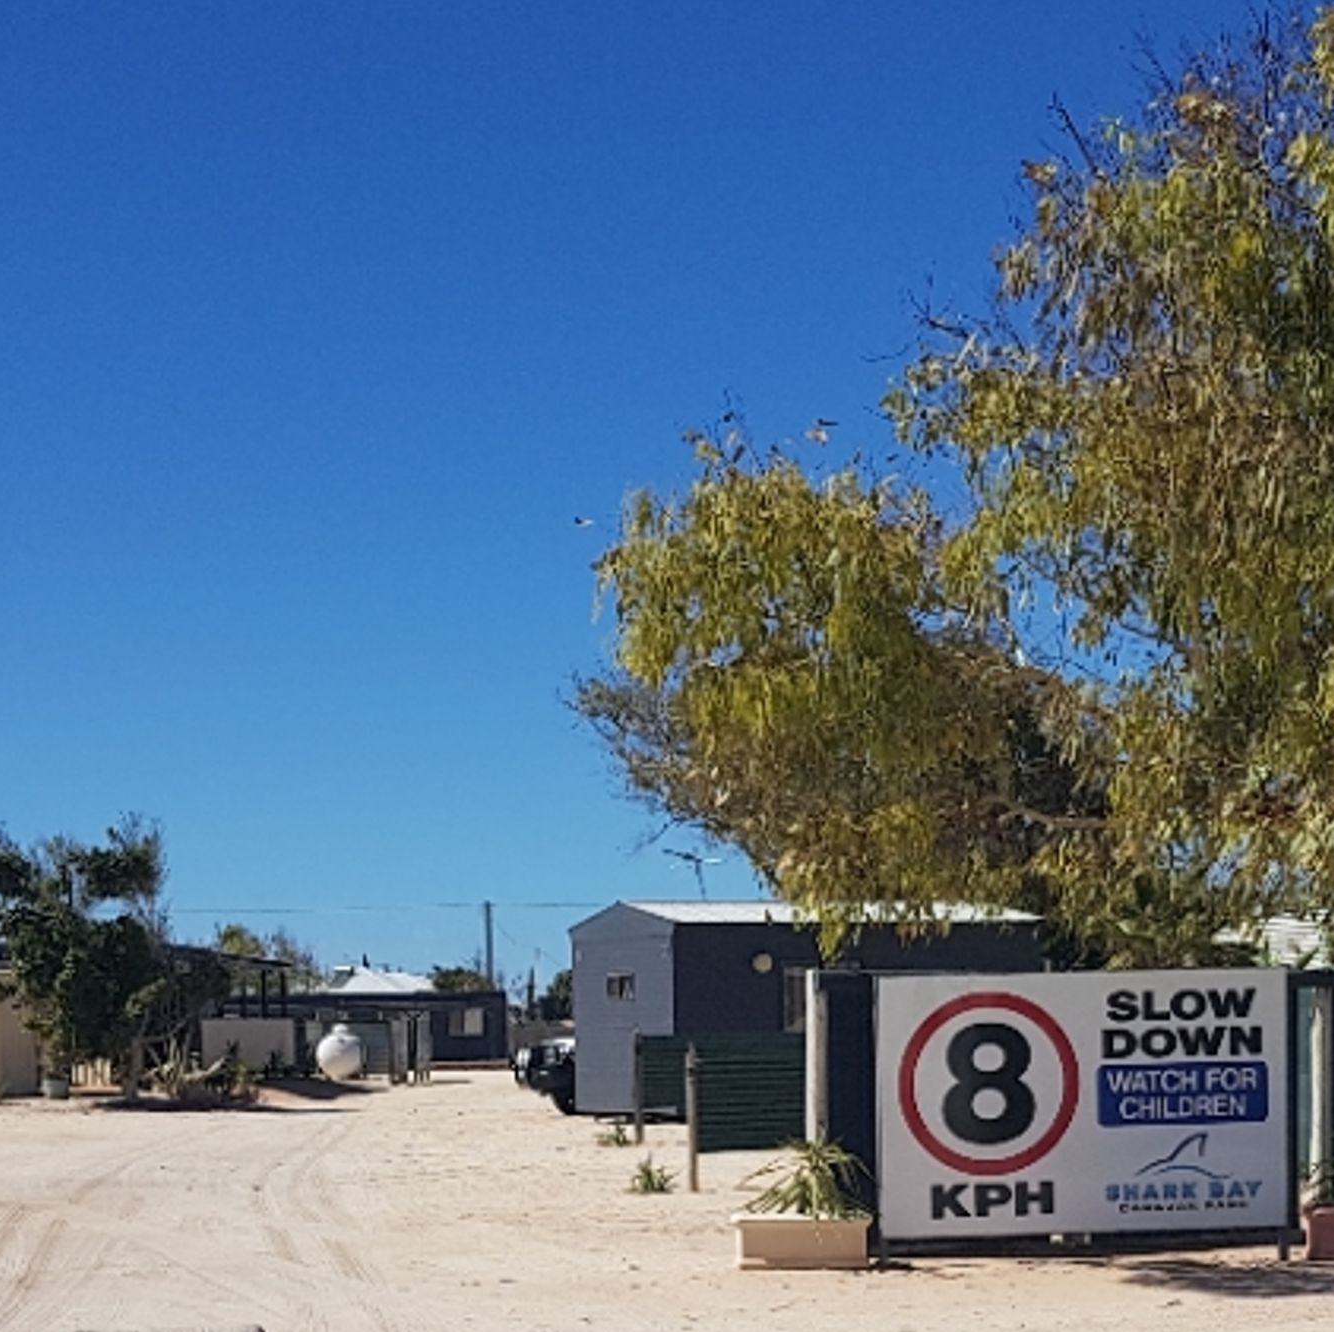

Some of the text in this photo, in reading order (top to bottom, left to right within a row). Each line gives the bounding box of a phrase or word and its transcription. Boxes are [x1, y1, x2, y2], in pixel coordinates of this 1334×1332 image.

[1106, 987, 1256, 1022] SLOW
[1101, 1026, 1262, 1059] DOWN
[942, 1022, 1036, 1145] 8
[1107, 1067, 1257, 1093] WATCH FOR
[1119, 1095, 1246, 1119] CHILDREN
[931, 1181, 1054, 1220] KPH
[1105, 1179, 1262, 1202] SHARK BAY
